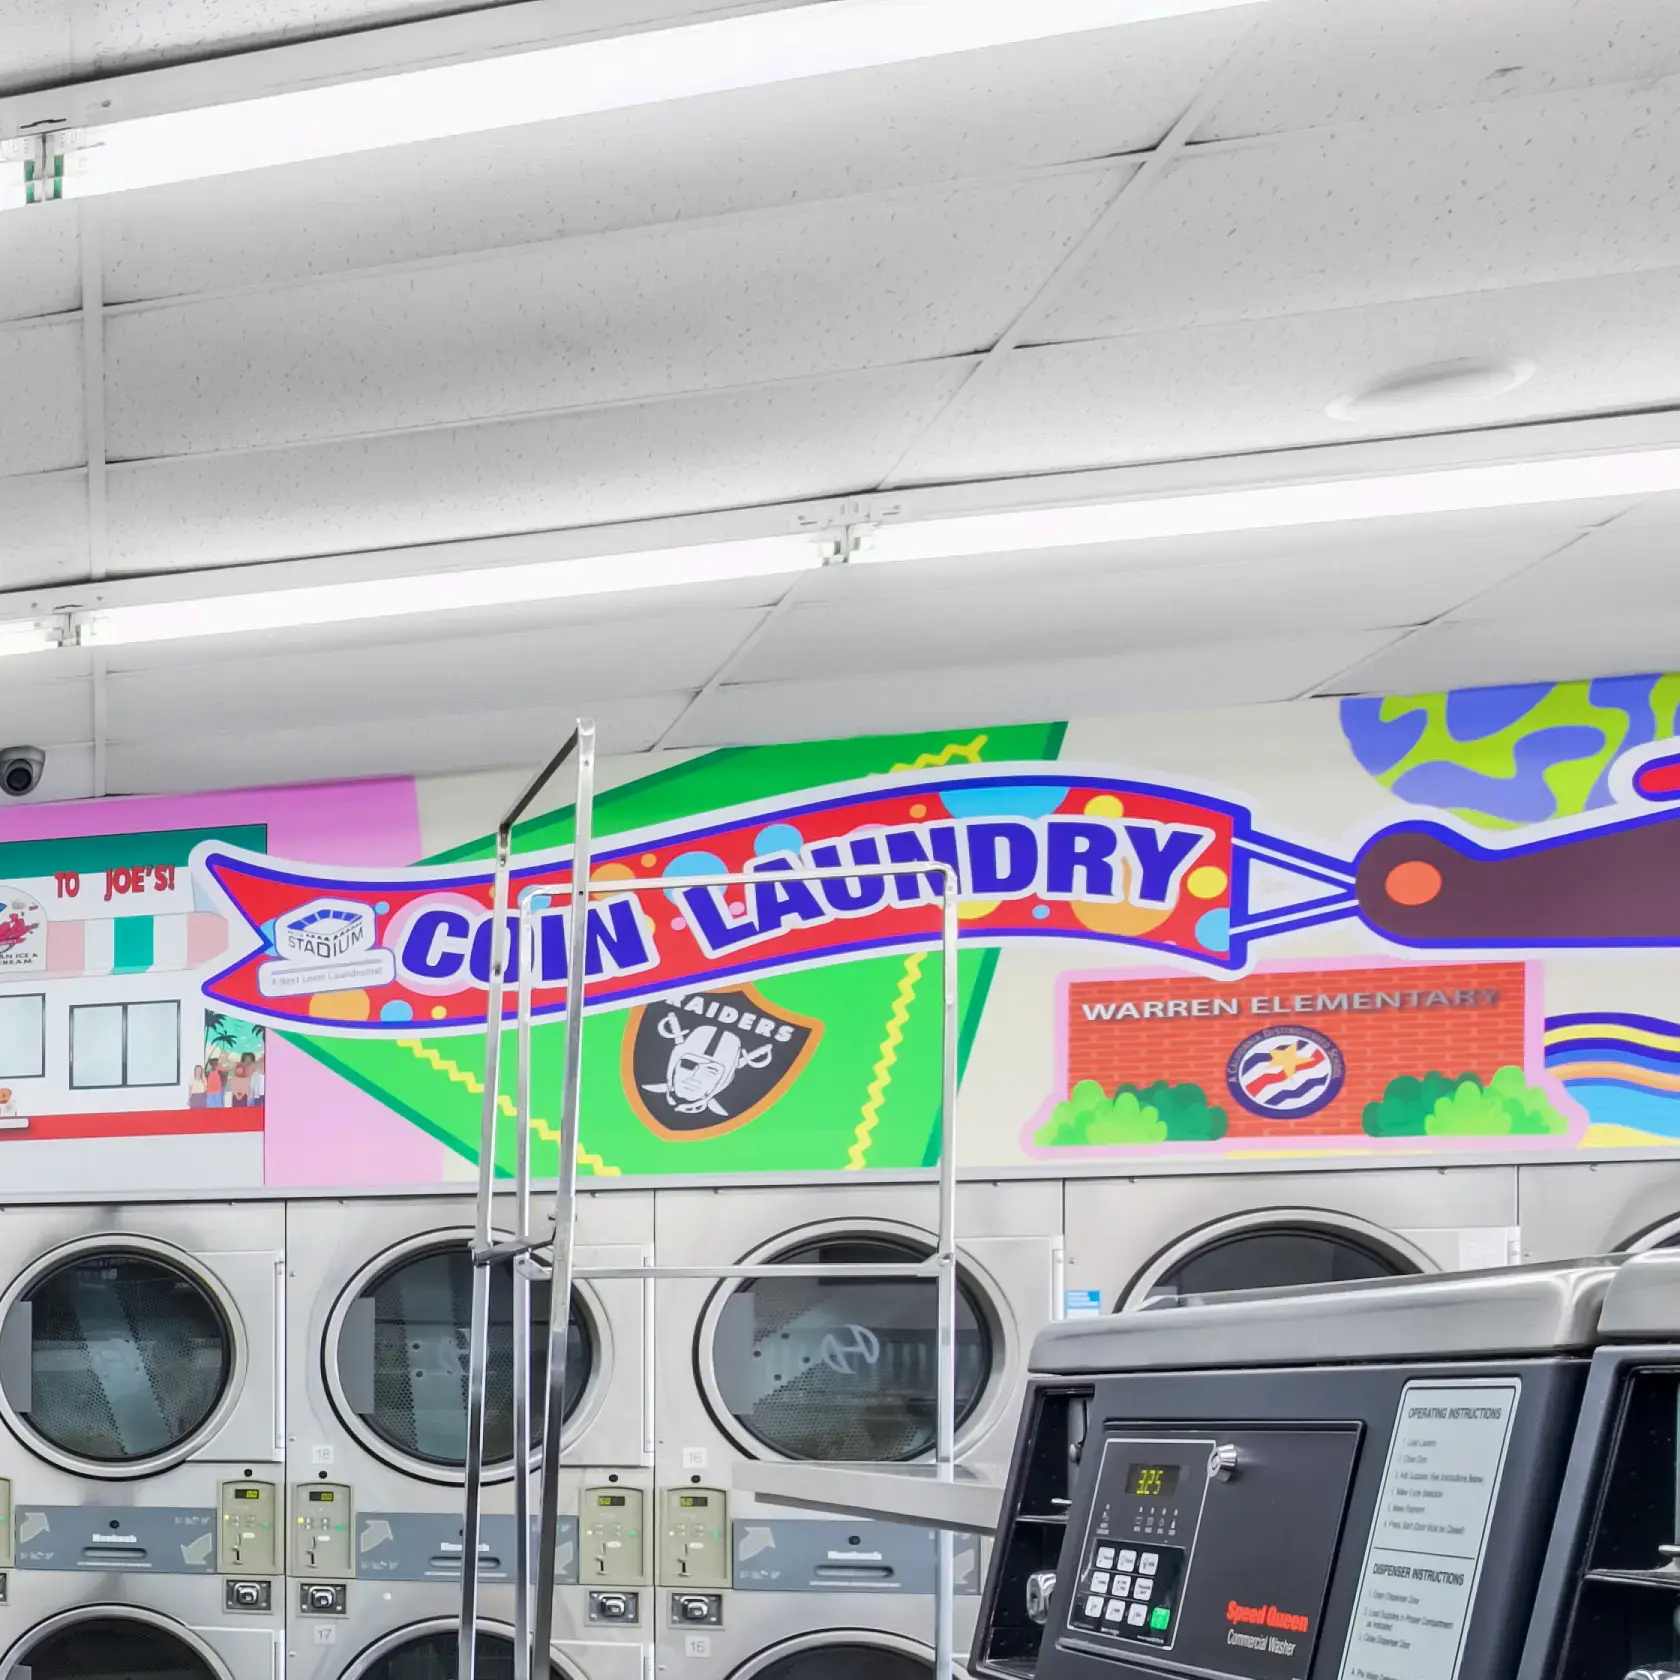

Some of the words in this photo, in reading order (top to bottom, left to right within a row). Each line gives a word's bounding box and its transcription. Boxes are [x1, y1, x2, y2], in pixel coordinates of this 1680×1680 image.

[55, 872, 80, 899] TO
[104, 863, 177, 902] JOE'S!
[401, 899, 650, 984] COIN
[680, 820, 1207, 952] LAUNDRY
[288, 926, 365, 959] STADIUM
[1082, 998, 1239, 1022] WARREN
[1250, 989, 1501, 1016] ELEMENTARY
[1408, 1407, 1448, 1420] OPERATING
[1447, 1407, 1502, 1420] INSTRUCTIONS
[316, 1449, 330, 1460] 18
[1372, 1563, 1411, 1579] DISPENSER
[1411, 1566, 1465, 1587] INSTRUCTIONS
[1226, 1600, 1267, 1625] Speed
[1266, 1605, 1309, 1633] Queen
[318, 1629, 331, 1640] 17
[1227, 1628, 1268, 1651] Commercial
[1268, 1636, 1296, 1656] Washer
